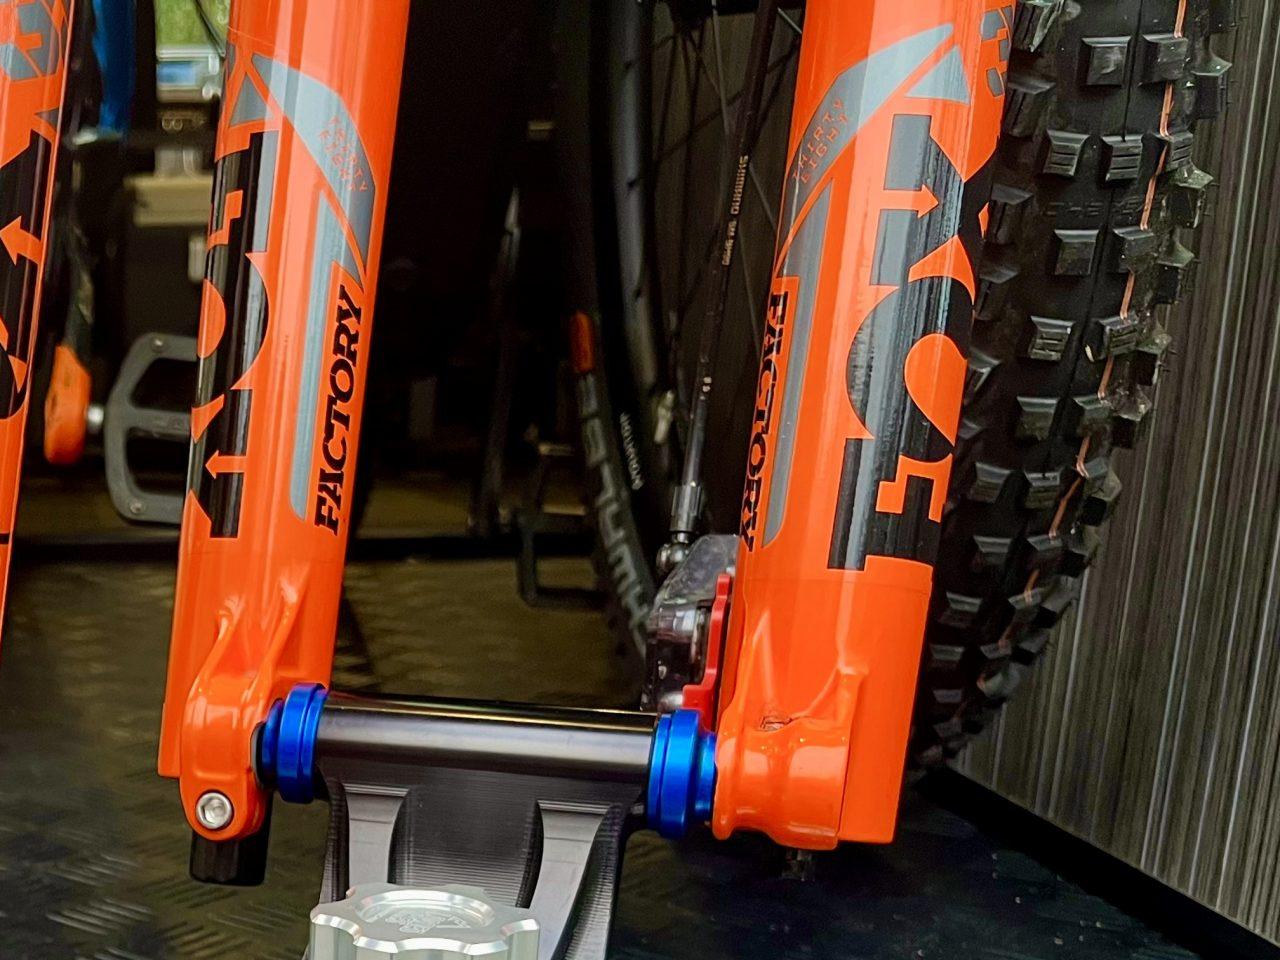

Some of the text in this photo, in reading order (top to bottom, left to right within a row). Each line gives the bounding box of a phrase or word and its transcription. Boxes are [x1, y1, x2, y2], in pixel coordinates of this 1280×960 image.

[314, 284, 362, 536] FACTORY
[739, 291, 789, 552] FACTORY
[827, 114, 991, 571] FOX
